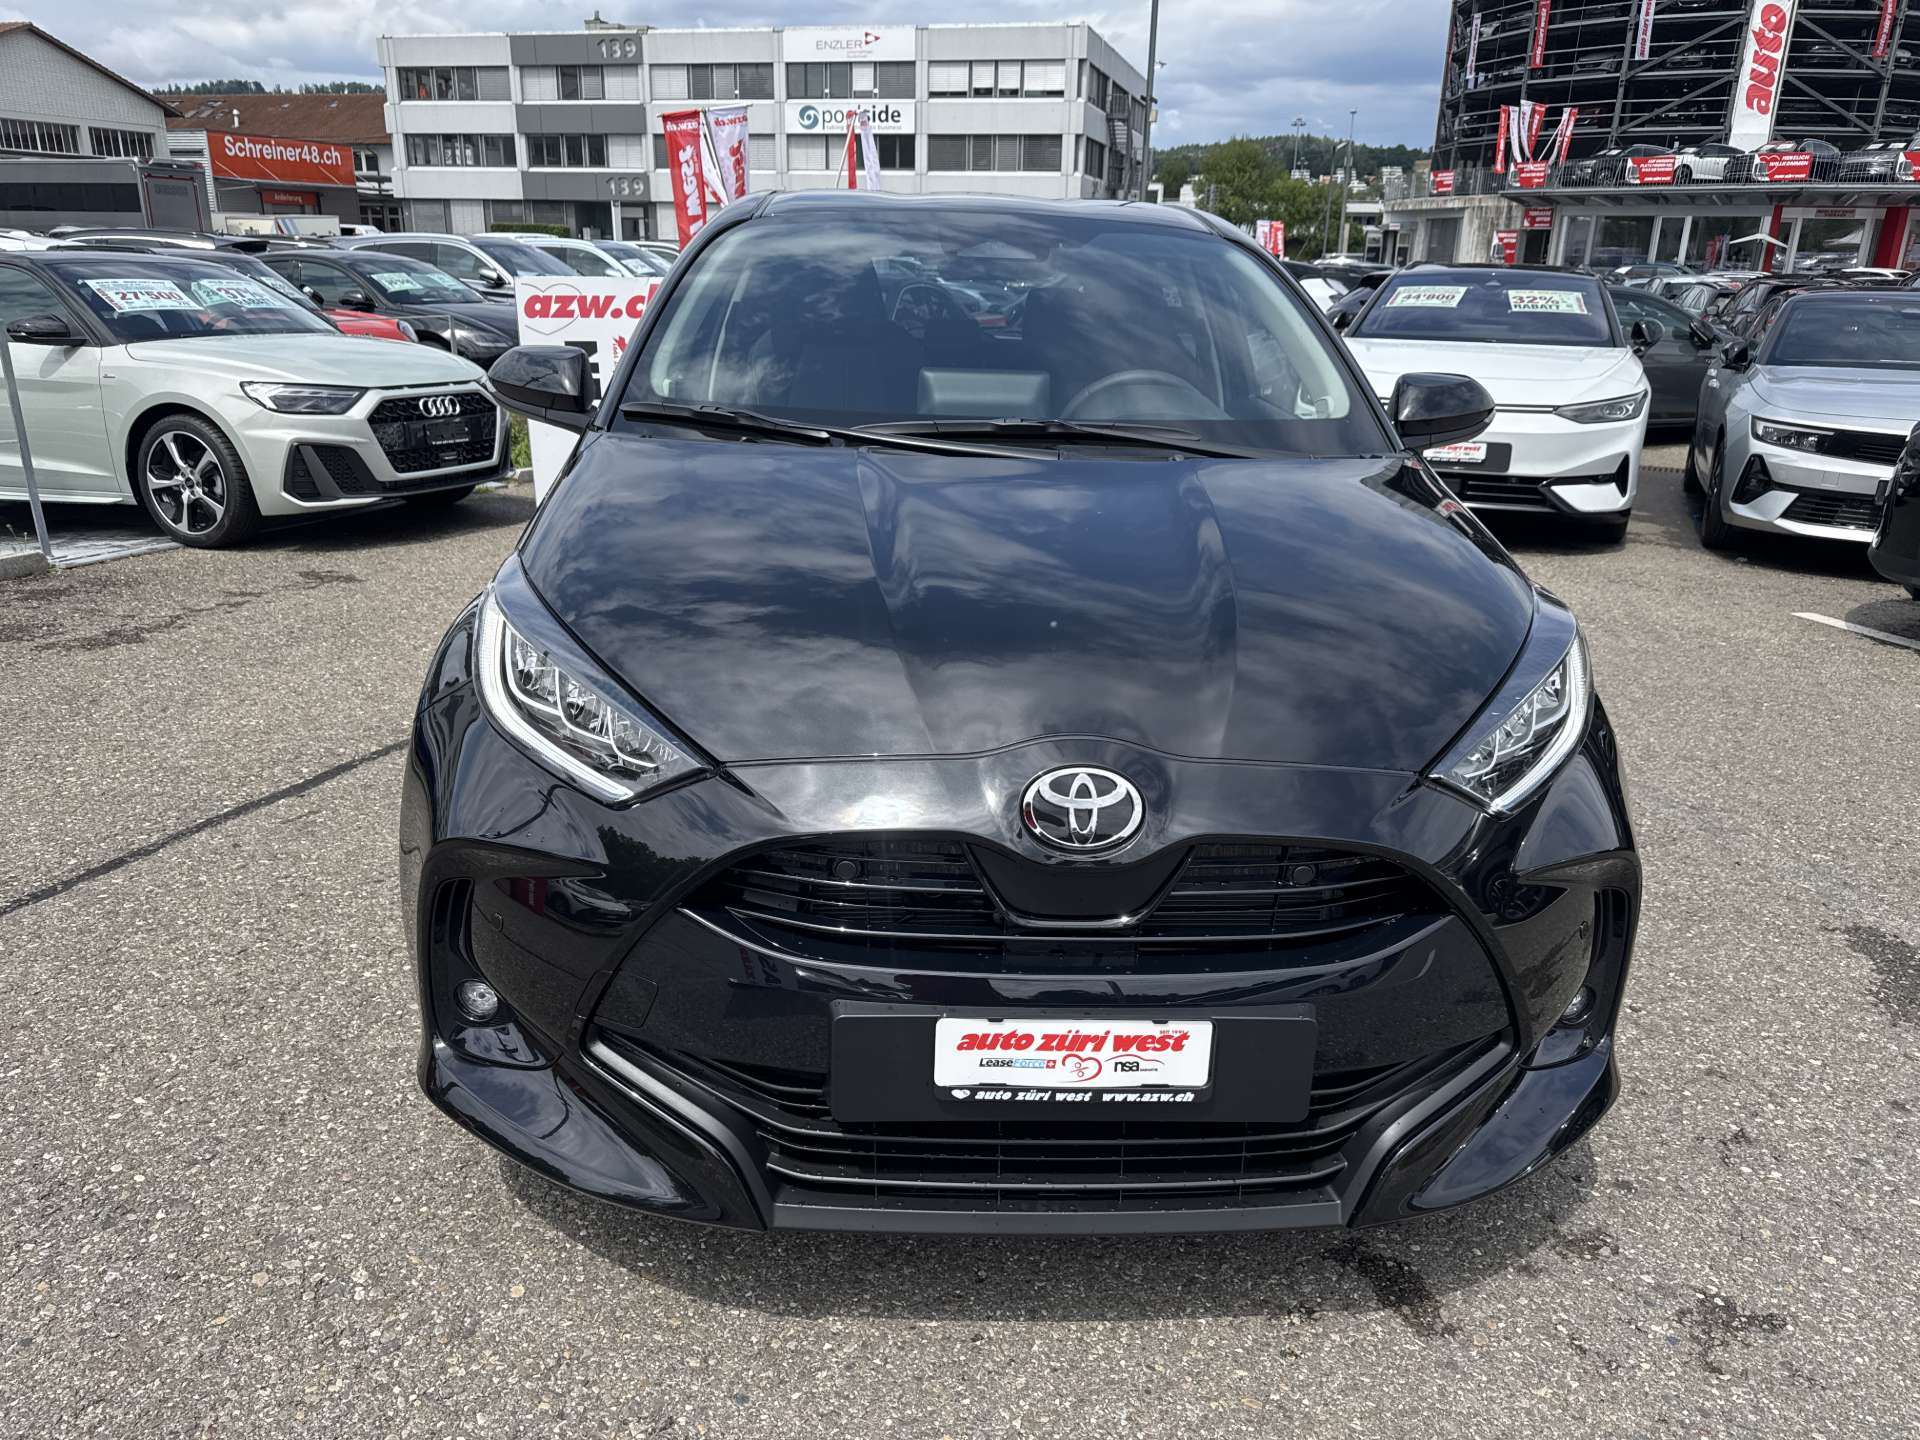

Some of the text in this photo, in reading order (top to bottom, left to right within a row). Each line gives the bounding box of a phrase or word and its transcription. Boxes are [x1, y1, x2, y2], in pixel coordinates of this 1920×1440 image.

[597, 38, 637, 58] 139
[816, 40, 863, 50] ENZLER
[1746, 4, 1787, 115] auto
[224, 136, 342, 166] Schreiner48.ch
[606, 176, 644, 196] 139
[115, 291, 184, 301] 27'500
[1511, 295, 1560, 304] 32%
[956, 1029, 1191, 1052] auto züri west
[979, 1058, 1045, 1068] LeaseForce
[1114, 1061, 1139, 1072] nsa
[975, 1090, 1195, 1102] auto züri west www.azw.ch
